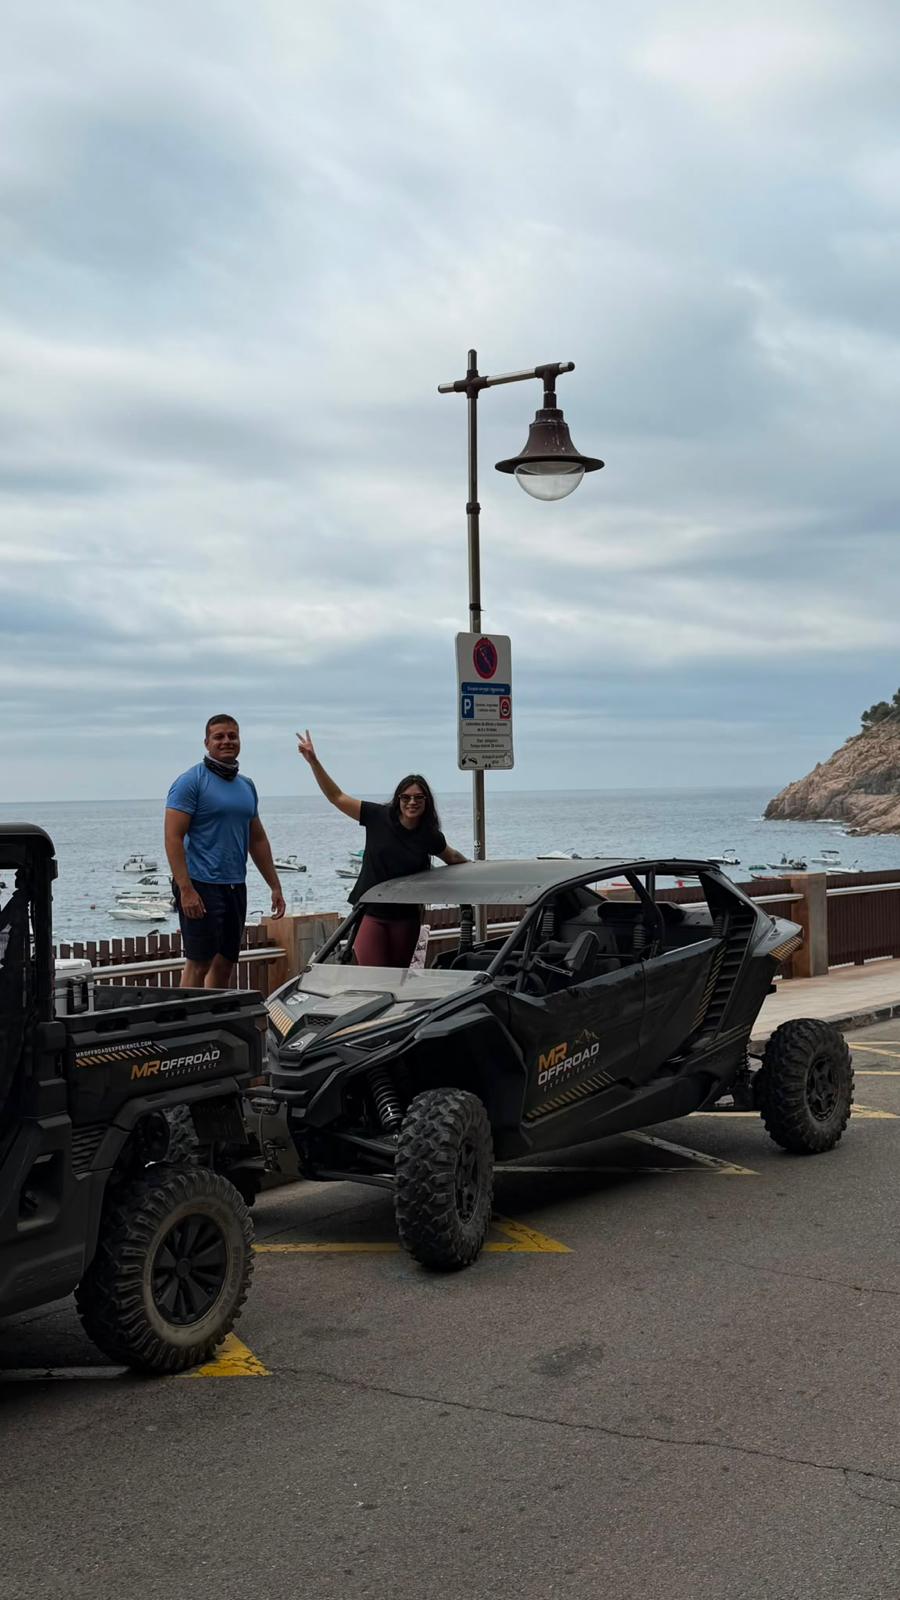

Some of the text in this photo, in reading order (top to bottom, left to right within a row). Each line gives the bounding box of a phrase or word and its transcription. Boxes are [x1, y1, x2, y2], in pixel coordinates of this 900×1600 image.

[464, 698, 472, 715] P
[75, 1040, 152, 1058] MROFFROADEXPERIENCE.COM
[538, 1042, 568, 1072] MR
[130, 1050, 221, 1080] MR OFFROAD
[537, 1043, 600, 1086] OFFROAD
